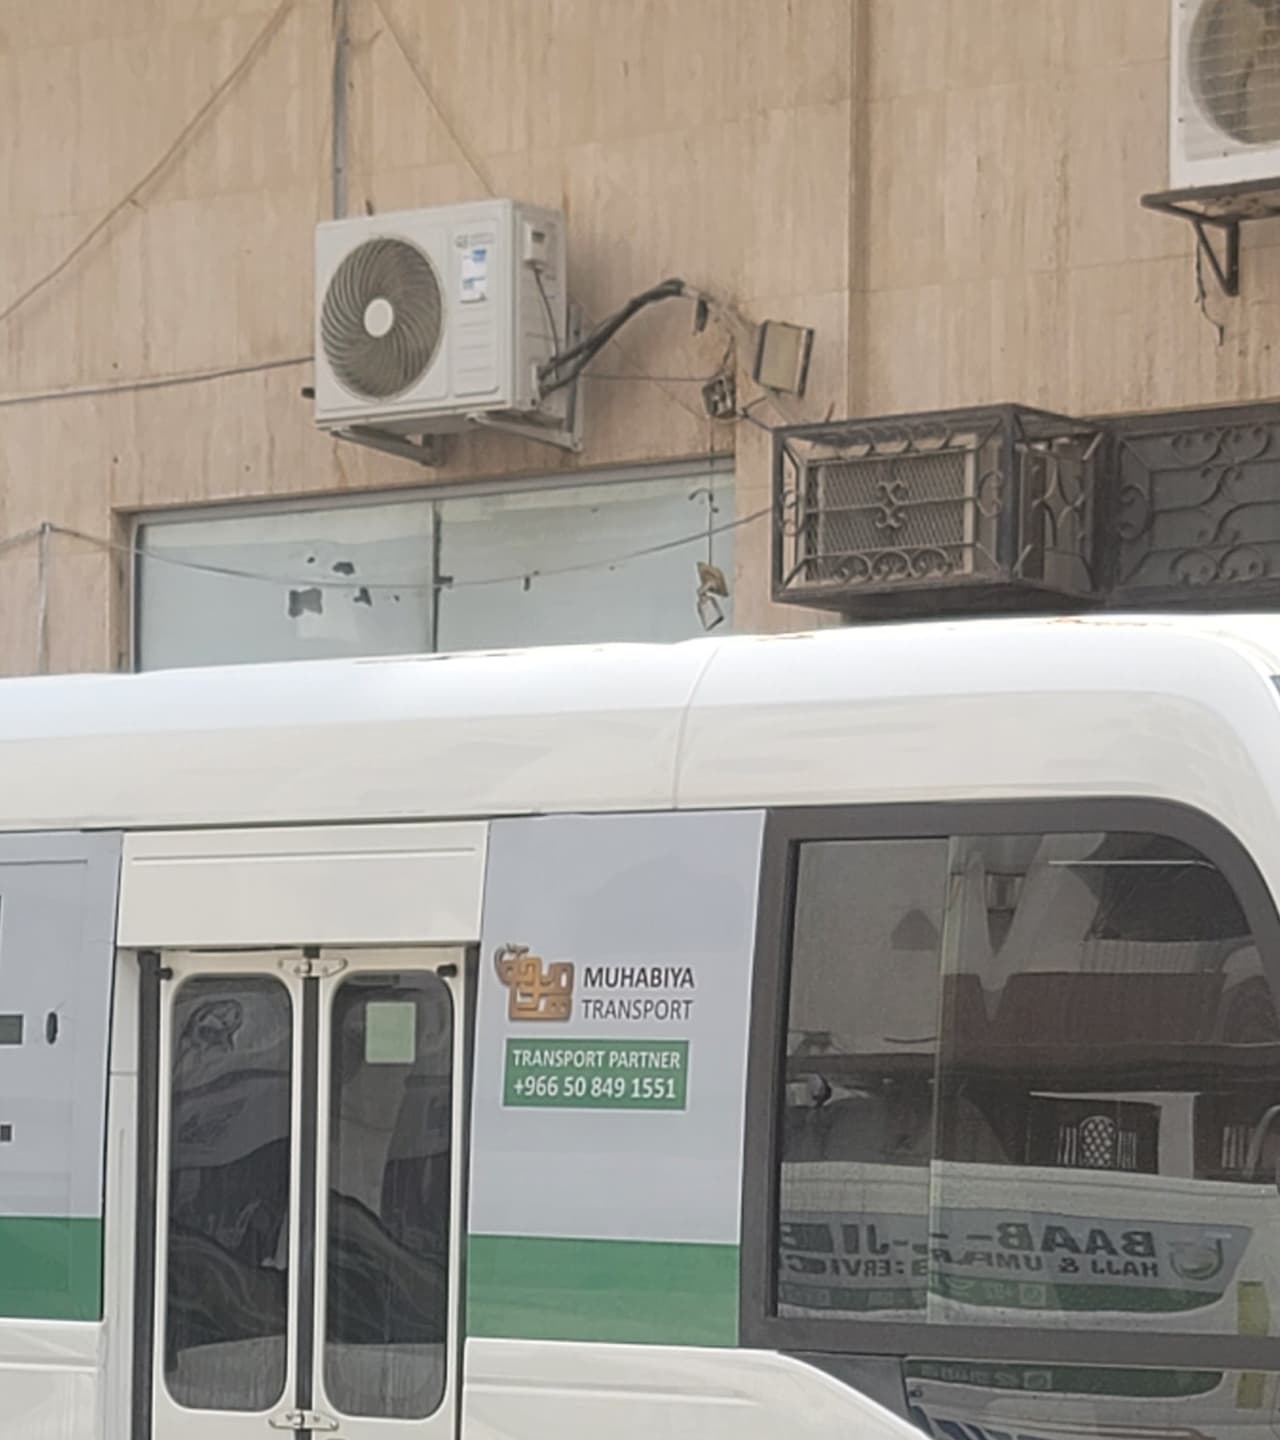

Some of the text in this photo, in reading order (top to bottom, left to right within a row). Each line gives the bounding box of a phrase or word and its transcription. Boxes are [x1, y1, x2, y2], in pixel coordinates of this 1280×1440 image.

[583, 967, 695, 989] MUHABIYA
[582, 999, 693, 1020] TRANSPORT
[513, 1049, 680, 1069] TRANSPORT PARTNER
[514, 1075, 676, 1098] +966 50 849 1551
